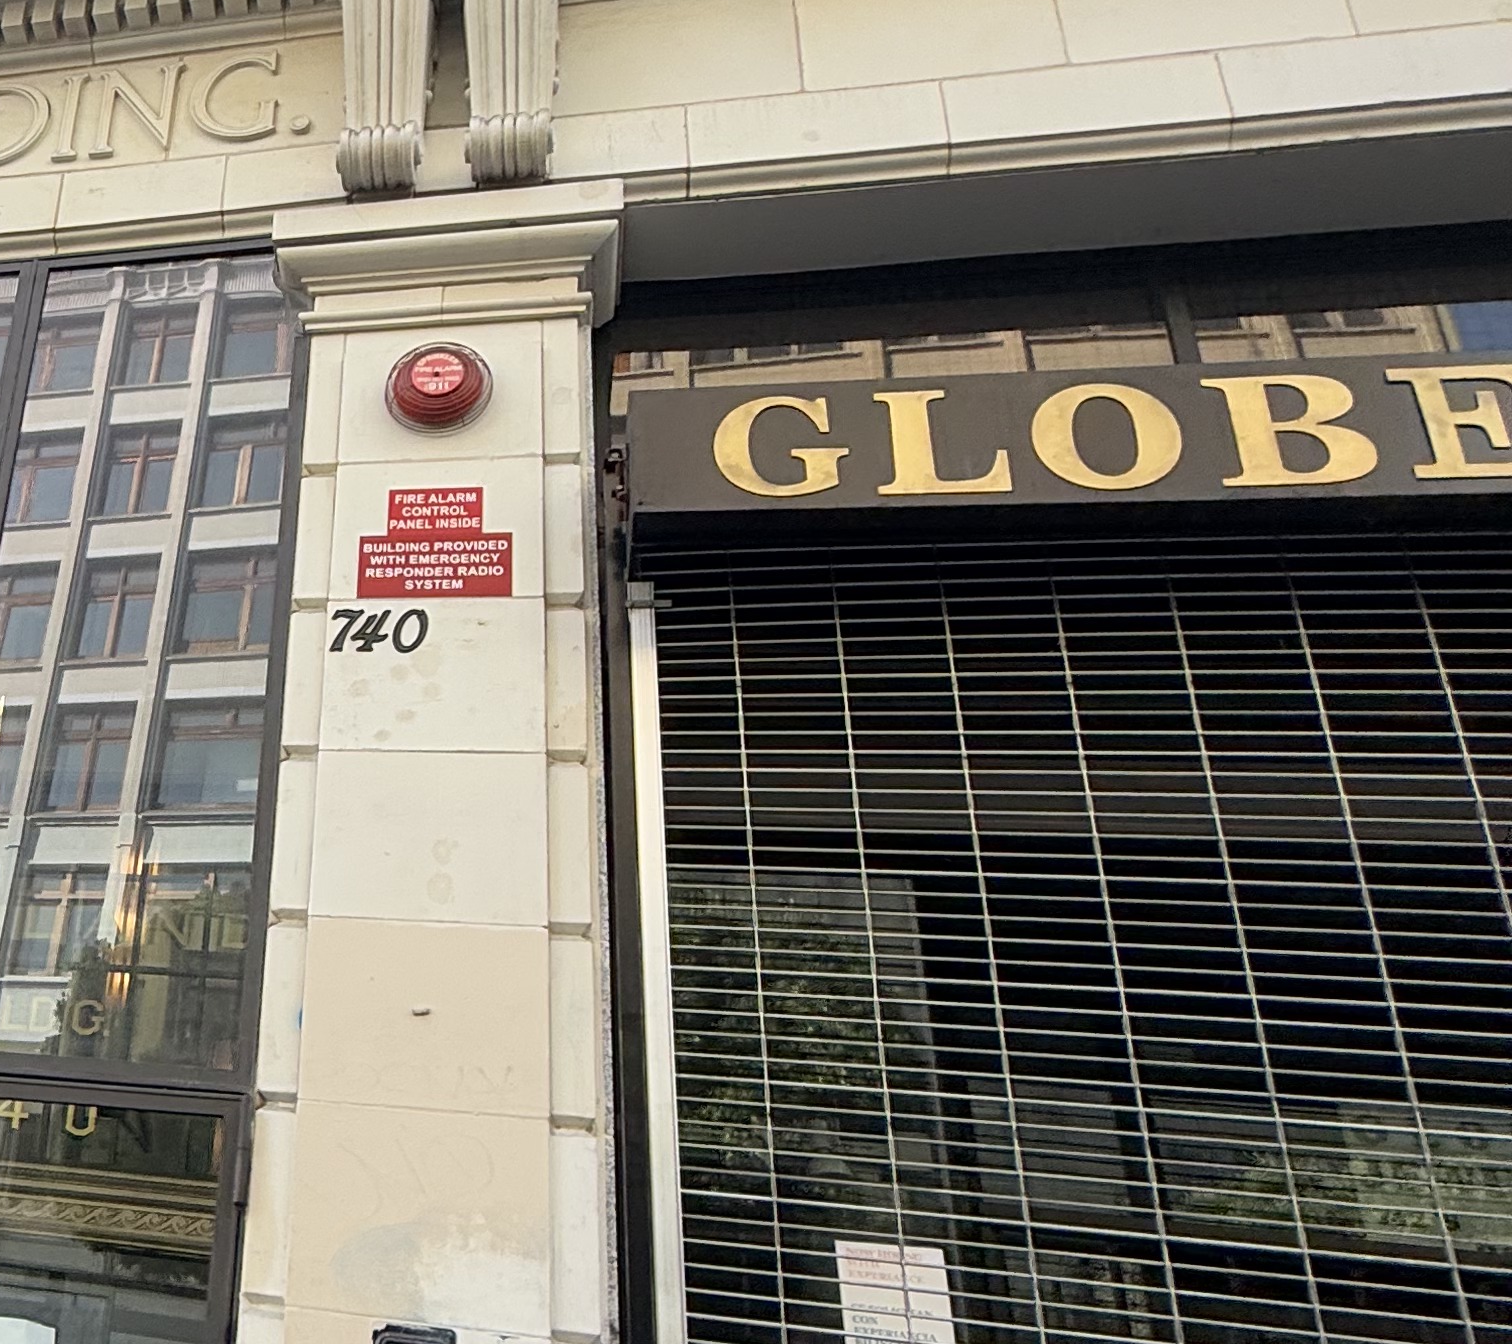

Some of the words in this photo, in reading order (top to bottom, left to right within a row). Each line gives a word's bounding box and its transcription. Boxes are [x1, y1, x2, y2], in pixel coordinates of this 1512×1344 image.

[712, 362, 1512, 498] GLOBE
[394, 493, 426, 504] FIRE
[428, 492, 477, 503] ALARM
[401, 505, 468, 517] CONTROL
[389, 519, 433, 530] PANEL
[435, 517, 481, 528] INSIDE
[363, 542, 430, 553] BUILDING
[433, 540, 508, 552] PROVIDED
[370, 555, 406, 565] WITH
[409, 553, 500, 565] EMERGENCY
[365, 567, 454, 578] RESPONDER
[457, 566, 504, 576] RADIO
[404, 579, 463, 590] SYSTEM
[329, 608, 429, 654] 740
[848, 1270, 924, 1284] EXPERIACE
